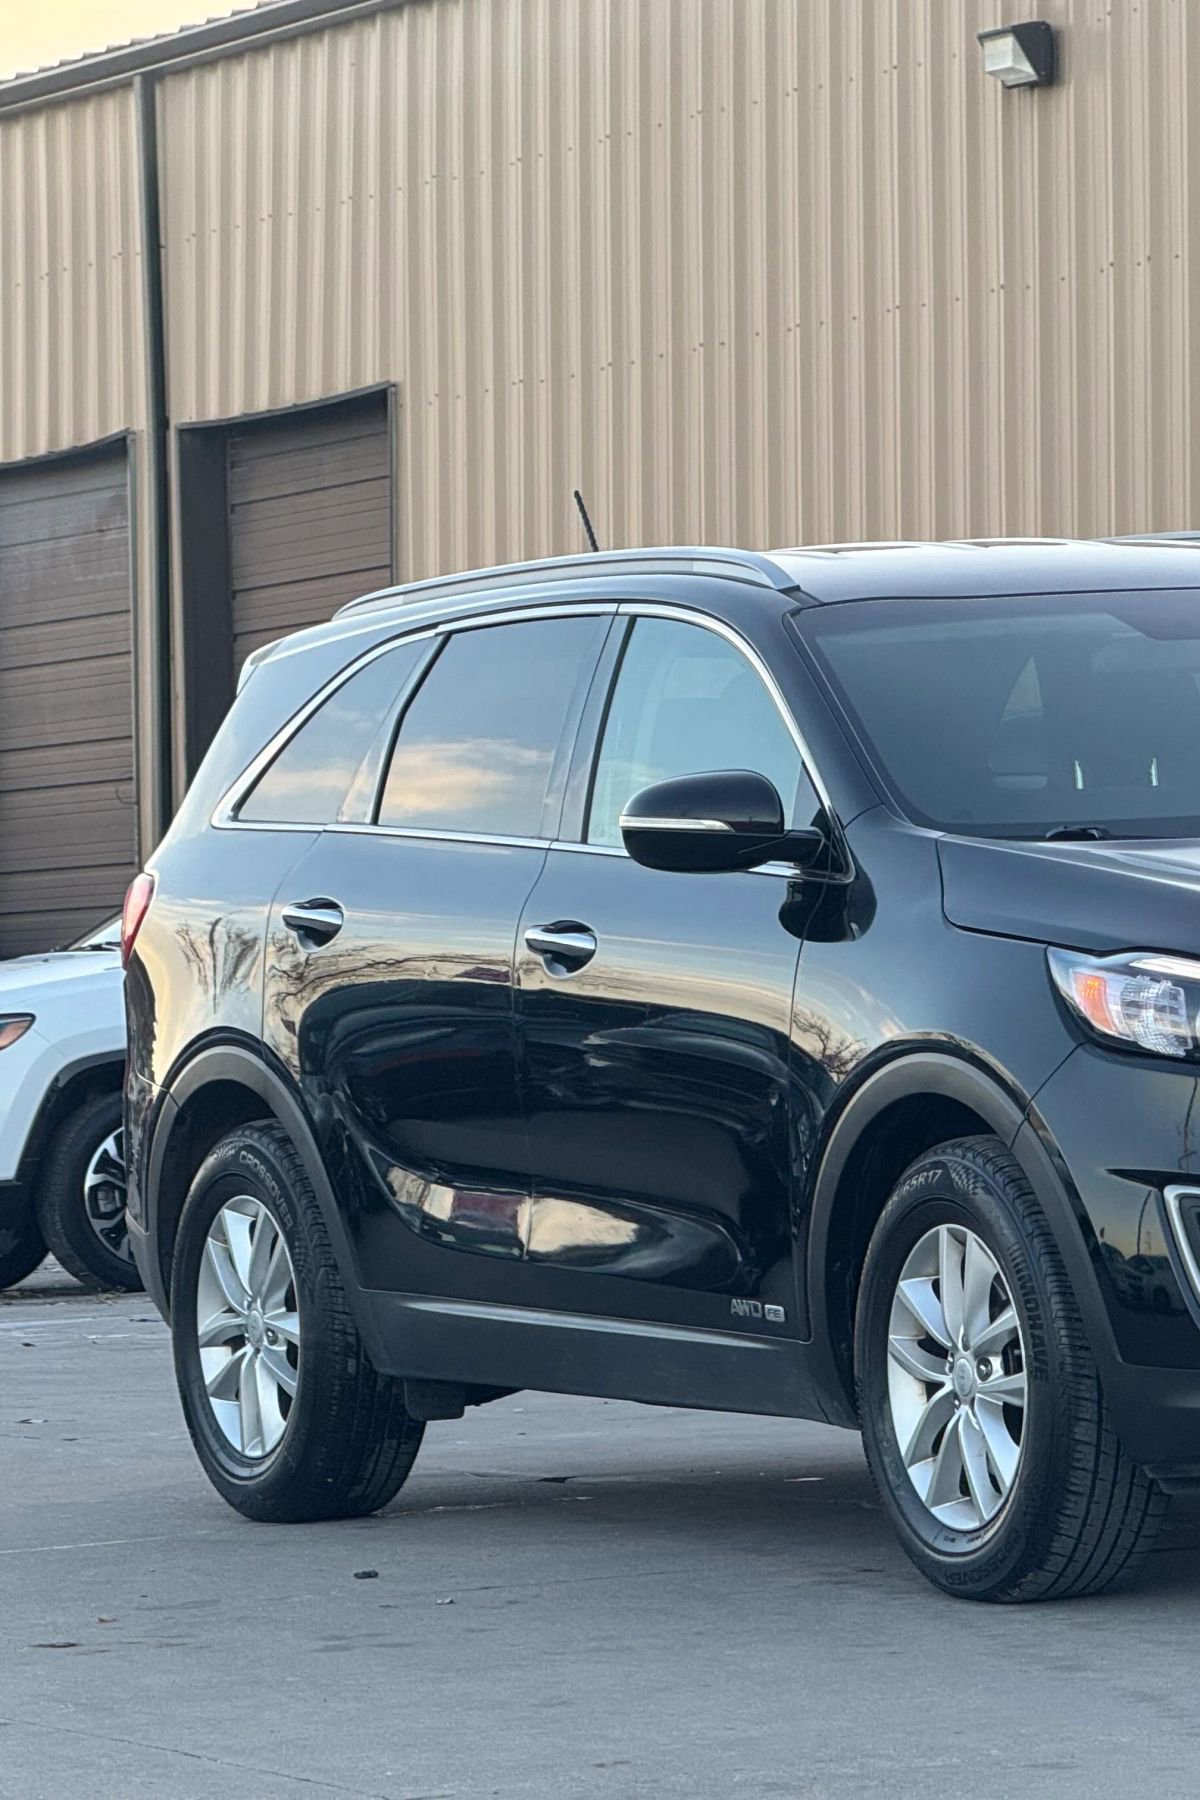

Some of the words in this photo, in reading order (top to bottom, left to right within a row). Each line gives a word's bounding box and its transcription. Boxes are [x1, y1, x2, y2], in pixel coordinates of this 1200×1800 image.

[239, 1150, 294, 1231] CROSSOVER
[730, 1298, 763, 1319] AWD
[1019, 1278, 1050, 1382] MOHAVE
